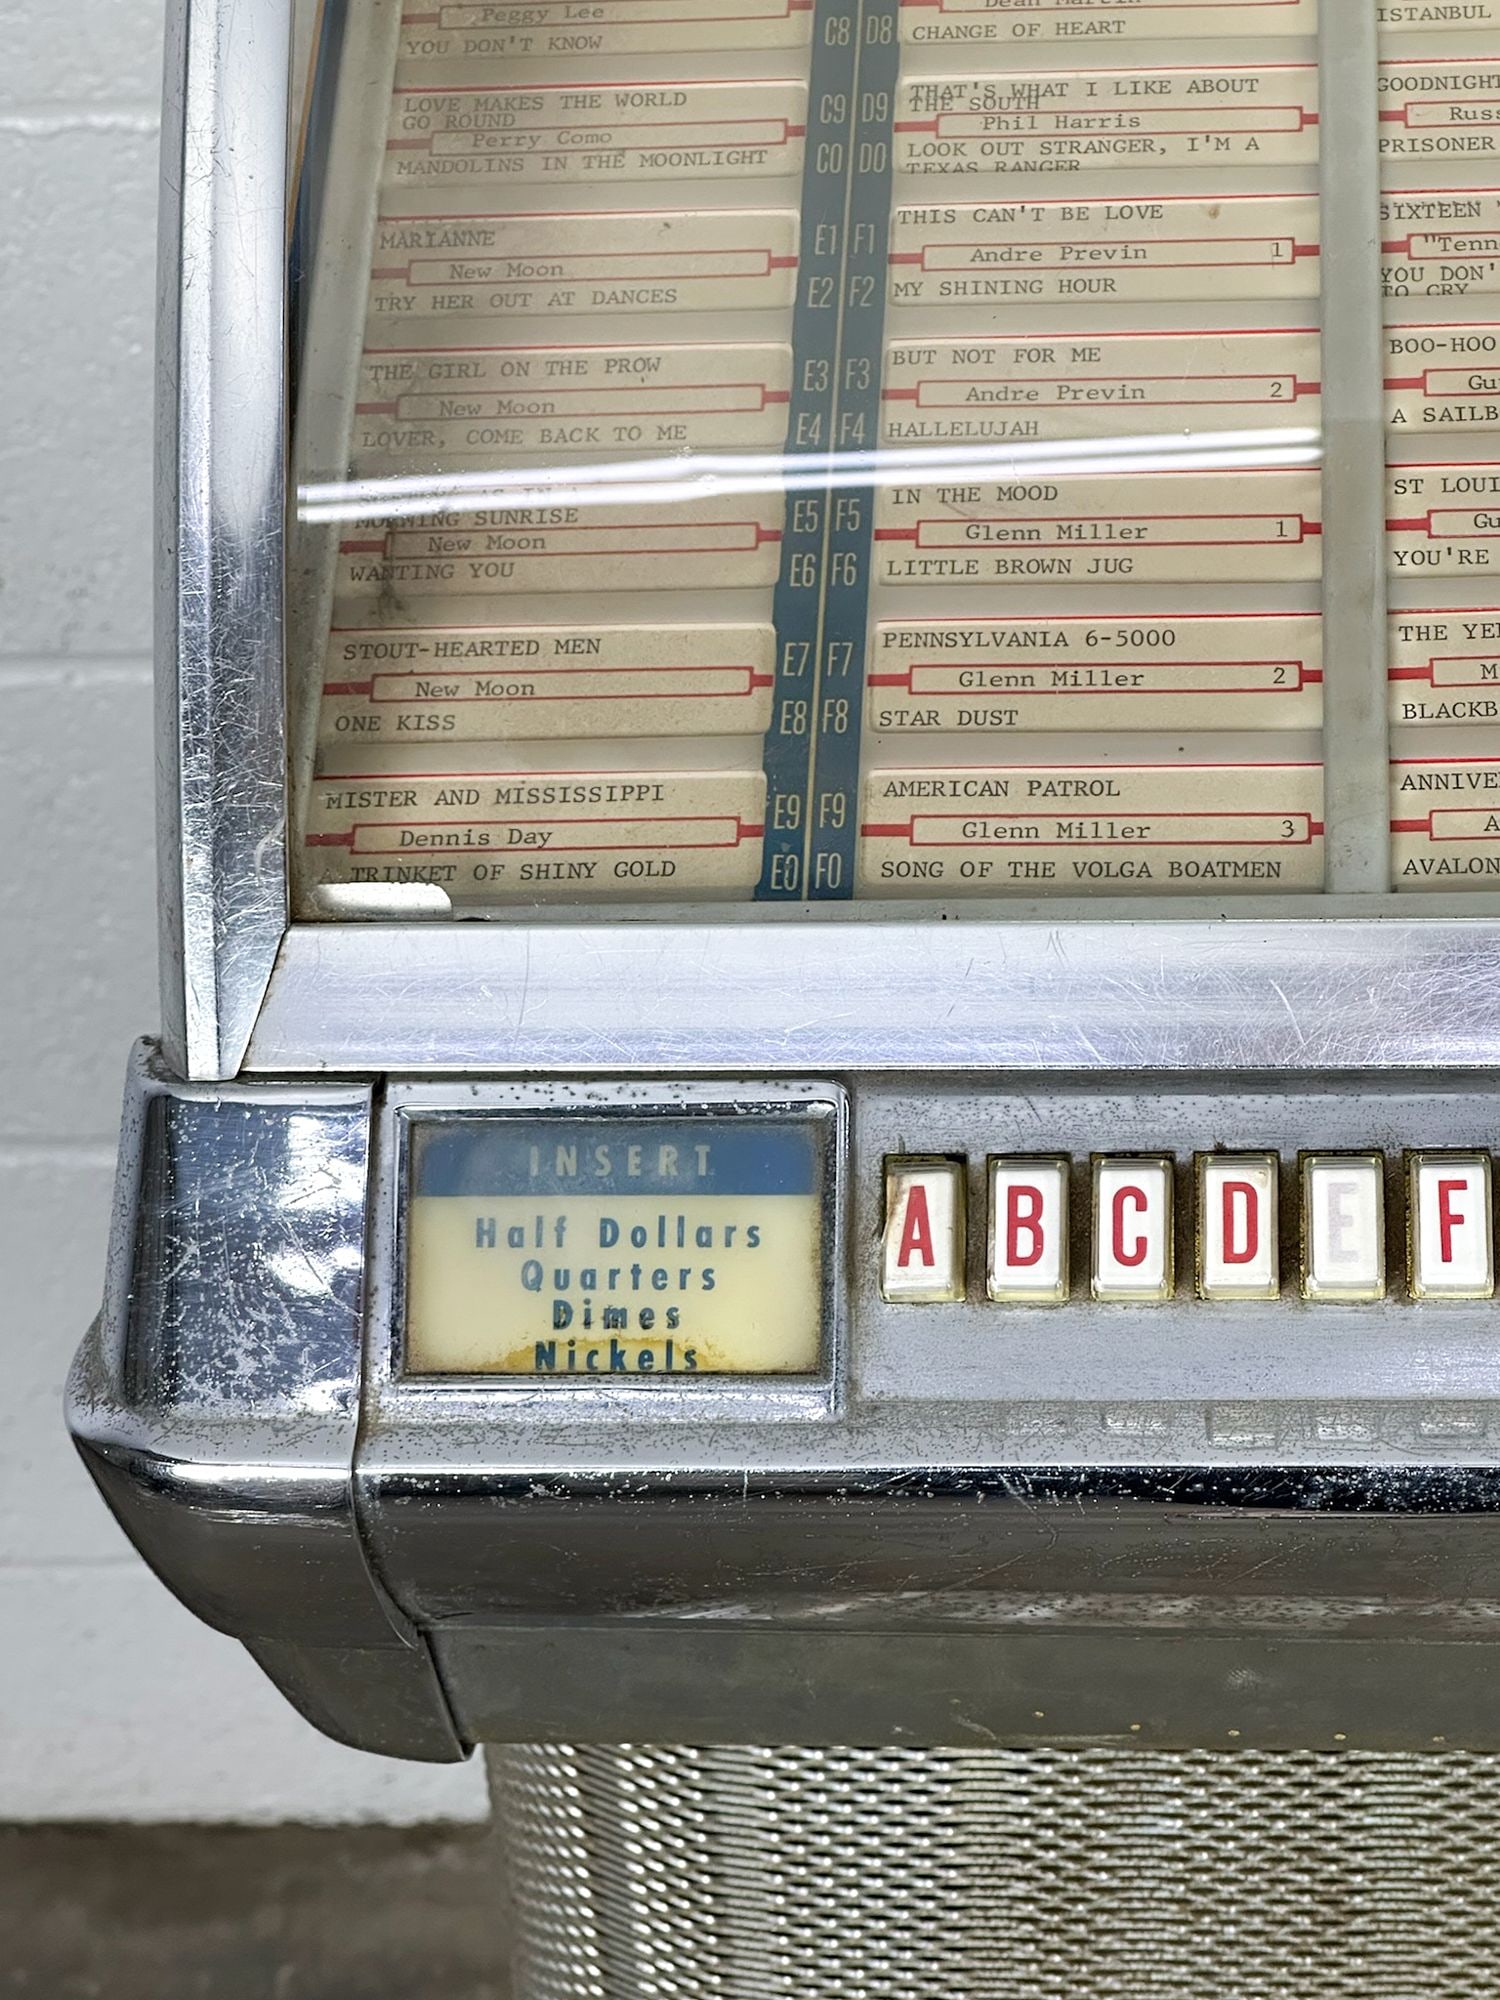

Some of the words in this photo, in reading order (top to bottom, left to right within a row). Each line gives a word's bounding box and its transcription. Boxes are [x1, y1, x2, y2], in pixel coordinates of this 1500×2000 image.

[1377, 5, 1491, 22] ISTANBUL
[824, 18, 850, 46] C8
[866, 16, 892, 44] D8
[913, 25, 996, 40] CHANGE
[1012, 23, 1040, 38] OF
[1056, 21, 1125, 36] HEART
[408, 40, 449, 55] YOU
[464, 37, 533, 53] DON'T
[549, 36, 602, 50] KNOW
[911, 84, 996, 100] THAT'S
[1013, 83, 1068, 98] WHAT
[1086, 82, 1098, 96] I
[1114, 80, 1171, 95] LIKE
[1186, 79, 1259, 94] ABOUT
[820, 96, 846, 123] C9
[862, 94, 888, 122] D9
[983, 116, 1038, 130] Phil
[1055, 115, 1141, 129] Harris
[908, 143, 965, 158] LOOK
[981, 142, 1023, 156] OUT
[1039, 139, 1167, 156] STRANGER,
[1188, 136, 1230, 152] I'M
[1245, 137, 1259, 151] A
[1379, 136, 1495, 153] PRISONER
[542, 157, 567, 170] IN
[583, 155, 624, 169] THE
[640, 150, 768, 167] MOONLIGHT
[816, 145, 842, 173] C0
[859, 144, 886, 172] D0
[898, 210, 956, 225] THIS
[973, 207, 1045, 223] CAN'T
[1061, 207, 1089, 221] BE
[1105, 205, 1163, 220] LOVE
[1380, 203, 1481, 221] SIXTEEN
[815, 226, 838, 255] E1
[855, 224, 875, 253] F1
[971, 248, 1042, 263] Andre
[1061, 246, 1148, 261] Previn
[1272, 243, 1283, 257] 1
[450, 264, 492, 279] New
[507, 262, 563, 277] Moon
[1381, 267, 1425, 283] YOU
[808, 277, 833, 307] E2
[850, 277, 874, 305] F2
[895, 283, 923, 298] MY
[939, 280, 1042, 296] SHINING
[1058, 278, 1116, 294] HOUR
[432, 296, 474, 310] HER
[490, 294, 532, 308] OUT
[548, 292, 575, 306] AT
[592, 289, 677, 305] DANCES
[1390, 336, 1496, 354] BOO-HOO
[893, 350, 937, 366] BUT
[953, 350, 996, 365] NOT
[1014, 348, 1056, 364] FOR
[1072, 348, 1100, 363] ME
[370, 365, 413, 381] THE
[428, 362, 486, 379] GIRL
[502, 362, 529, 376] ON
[547, 360, 588, 376] THE
[605, 358, 661, 374] PROW
[803, 361, 828, 391] E3
[845, 358, 870, 389] F3
[966, 385, 1039, 402] Andre
[1057, 384, 1146, 400] Previn
[1270, 382, 1282, 398] 2
[440, 401, 481, 416] New
[498, 400, 555, 414] Moon
[1391, 409, 1407, 423] A
[362, 431, 445, 449] LOVER,
[467, 429, 523, 445] COME
[541, 427, 600, 444] BACK
[614, 426, 641, 440] TO
[658, 425, 686, 440] ME
[794, 414, 821, 446] E4
[840, 413, 865, 444] F4
[888, 421, 1039, 438] HALLELUJAH
[892, 488, 921, 505] IN
[938, 487, 981, 503] THE
[998, 485, 1058, 502] MOOD
[1394, 479, 1424, 495] ST
[474, 508, 579, 526] SUNRISE
[793, 501, 818, 533] E5
[836, 500, 860, 531] F5
[966, 524, 1041, 541] Glenn
[1057, 523, 1148, 539] Miller
[1276, 521, 1288, 537] 1
[428, 537, 471, 552] New
[487, 535, 547, 550] Moon
[1394, 547, 1489, 566] YOU'RE
[470, 562, 514, 578] YOU
[789, 554, 816, 588] E6
[831, 553, 857, 586] F6
[887, 559, 979, 576] LITTLE
[996, 558, 1071, 575] BROWN
[1088, 558, 1133, 575] JUG
[883, 631, 1069, 649] PENNSYLVANIA
[1086, 630, 1175, 647] 6-5000
[1398, 625, 1448, 642] THE
[344, 639, 539, 660] STOUT-HEARTED
[554, 638, 600, 654] MEN
[781, 641, 810, 675] E7
[827, 642, 853, 677] F7
[959, 671, 1035, 688] Glenn
[1052, 670, 1144, 687] Miller
[1273, 668, 1286, 684] 2
[415, 682, 459, 698] New
[475, 680, 535, 696] Moon
[778, 699, 808, 736] E8
[822, 699, 848, 733] F8
[880, 711, 940, 727] STAR
[958, 710, 1018, 726] DUST
[1402, 701, 1498, 720] BLACKB
[335, 716, 380, 731] ONE
[397, 715, 455, 730] KISS
[326, 790, 418, 809] MISTER
[434, 789, 480, 805] AND
[496, 785, 664, 804] MISSISSIPPI
[884, 780, 1009, 798] AMERICAN
[1028, 780, 1120, 797] PATROL
[772, 791, 803, 829] E9
[819, 792, 846, 829] F9
[400, 830, 489, 846] Dennis
[509, 829, 553, 848] Day
[963, 822, 1039, 839] Glenn
[1057, 821, 1151, 839] Miller
[1281, 820, 1294, 837] 3
[474, 864, 505, 880] OF
[520, 862, 596, 880] SHINY
[614, 861, 676, 877] GOLD
[767, 855, 801, 893] E0
[815, 852, 842, 888] F0
[881, 861, 944, 878] SONG
[960, 861, 993, 878] OF
[1008, 861, 1056, 878] THE
[1073, 861, 1152, 878] VOLGA
[1169, 861, 1281, 878] BOATMEN
[530, 1144, 711, 1176] INSERT
[897, 1185, 934, 1267] A
[1006, 1185, 1044, 1267] B
[1113, 1185, 1148, 1267] C
[1223, 1181, 1258, 1264] D
[1438, 1180, 1468, 1263] F
[476, 1215, 568, 1249] Half
[600, 1215, 760, 1249] Dollars
[521, 1259, 716, 1292] Quarters
[553, 1299, 681, 1330] Dimes
[535, 1339, 697, 1371] Nickels
